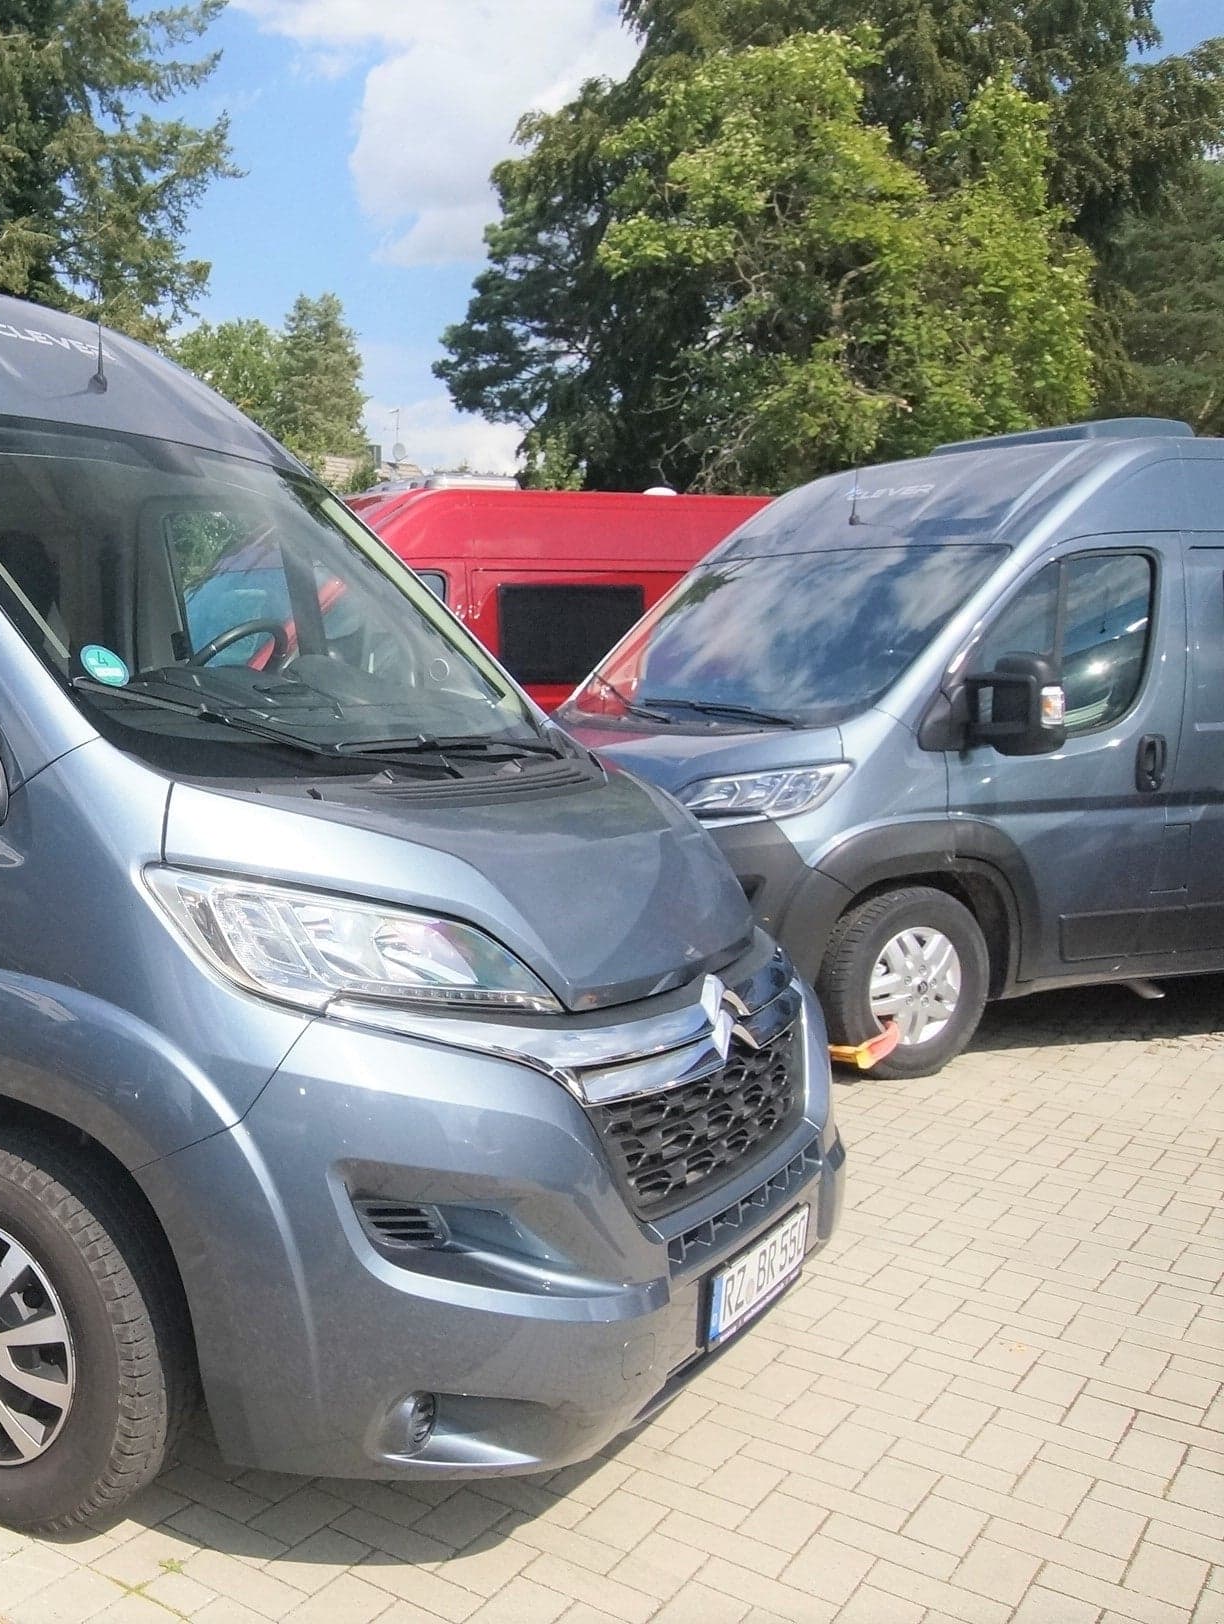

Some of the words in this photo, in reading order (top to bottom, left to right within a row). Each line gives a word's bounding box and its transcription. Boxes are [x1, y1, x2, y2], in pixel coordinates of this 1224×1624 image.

[722, 1267, 746, 1322] RZ
[756, 1239, 777, 1293] BR
[779, 1214, 806, 1272] 550
